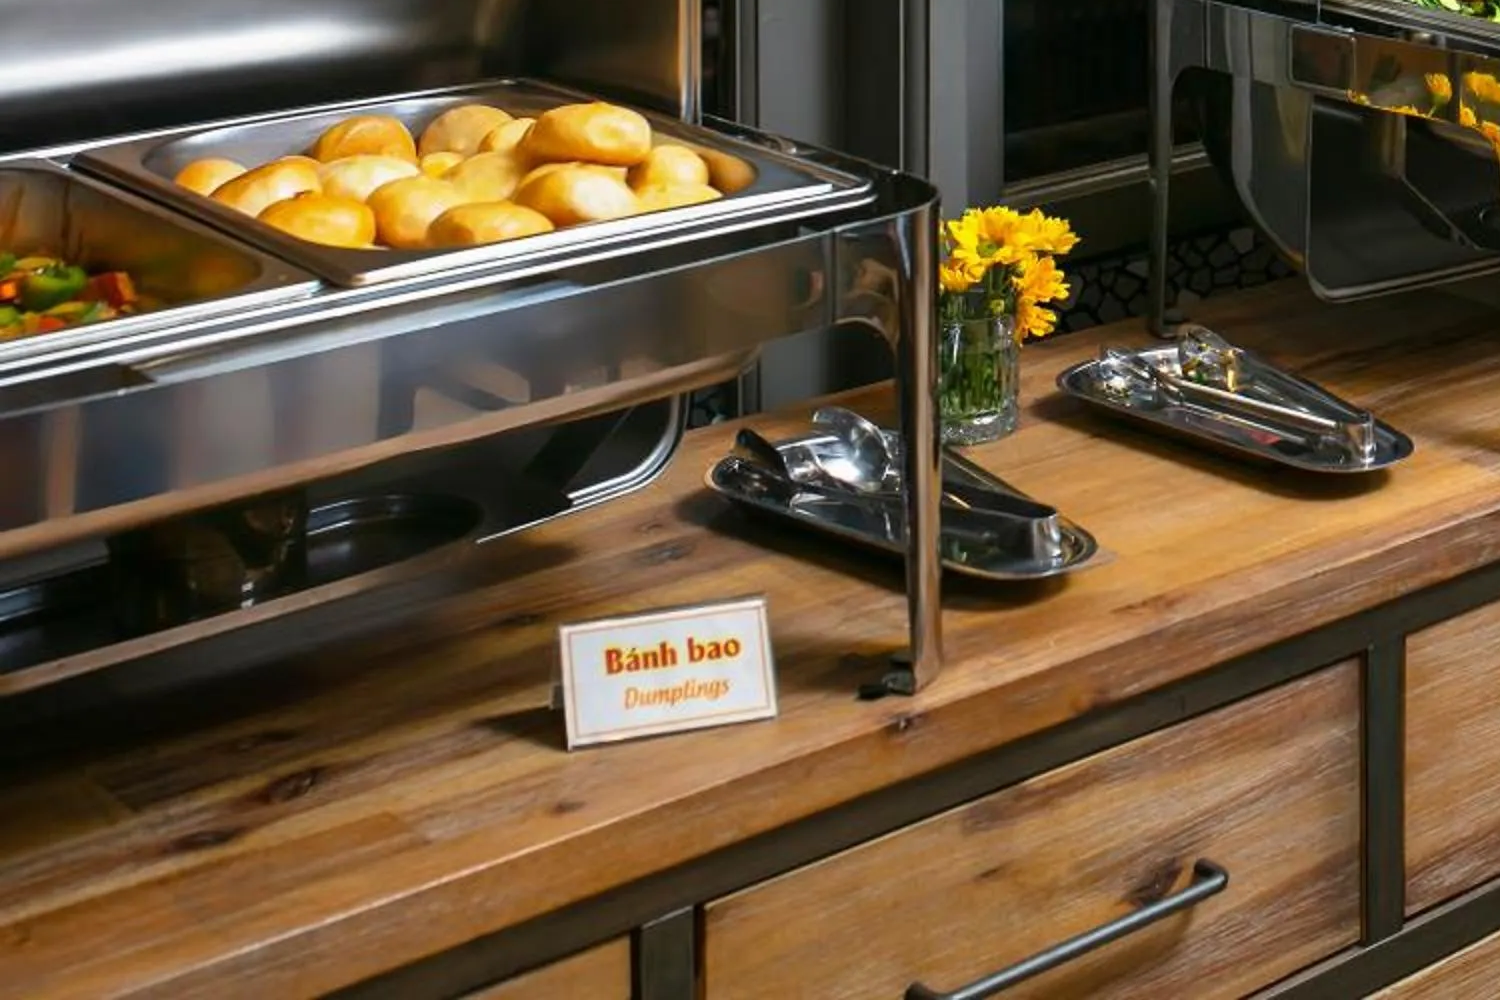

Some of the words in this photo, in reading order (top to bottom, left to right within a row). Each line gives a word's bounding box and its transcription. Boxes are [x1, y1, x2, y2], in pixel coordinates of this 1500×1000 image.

[604, 641, 678, 675] Bánh
[687, 636, 741, 663] bao
[624, 677, 731, 710] Dumplings
